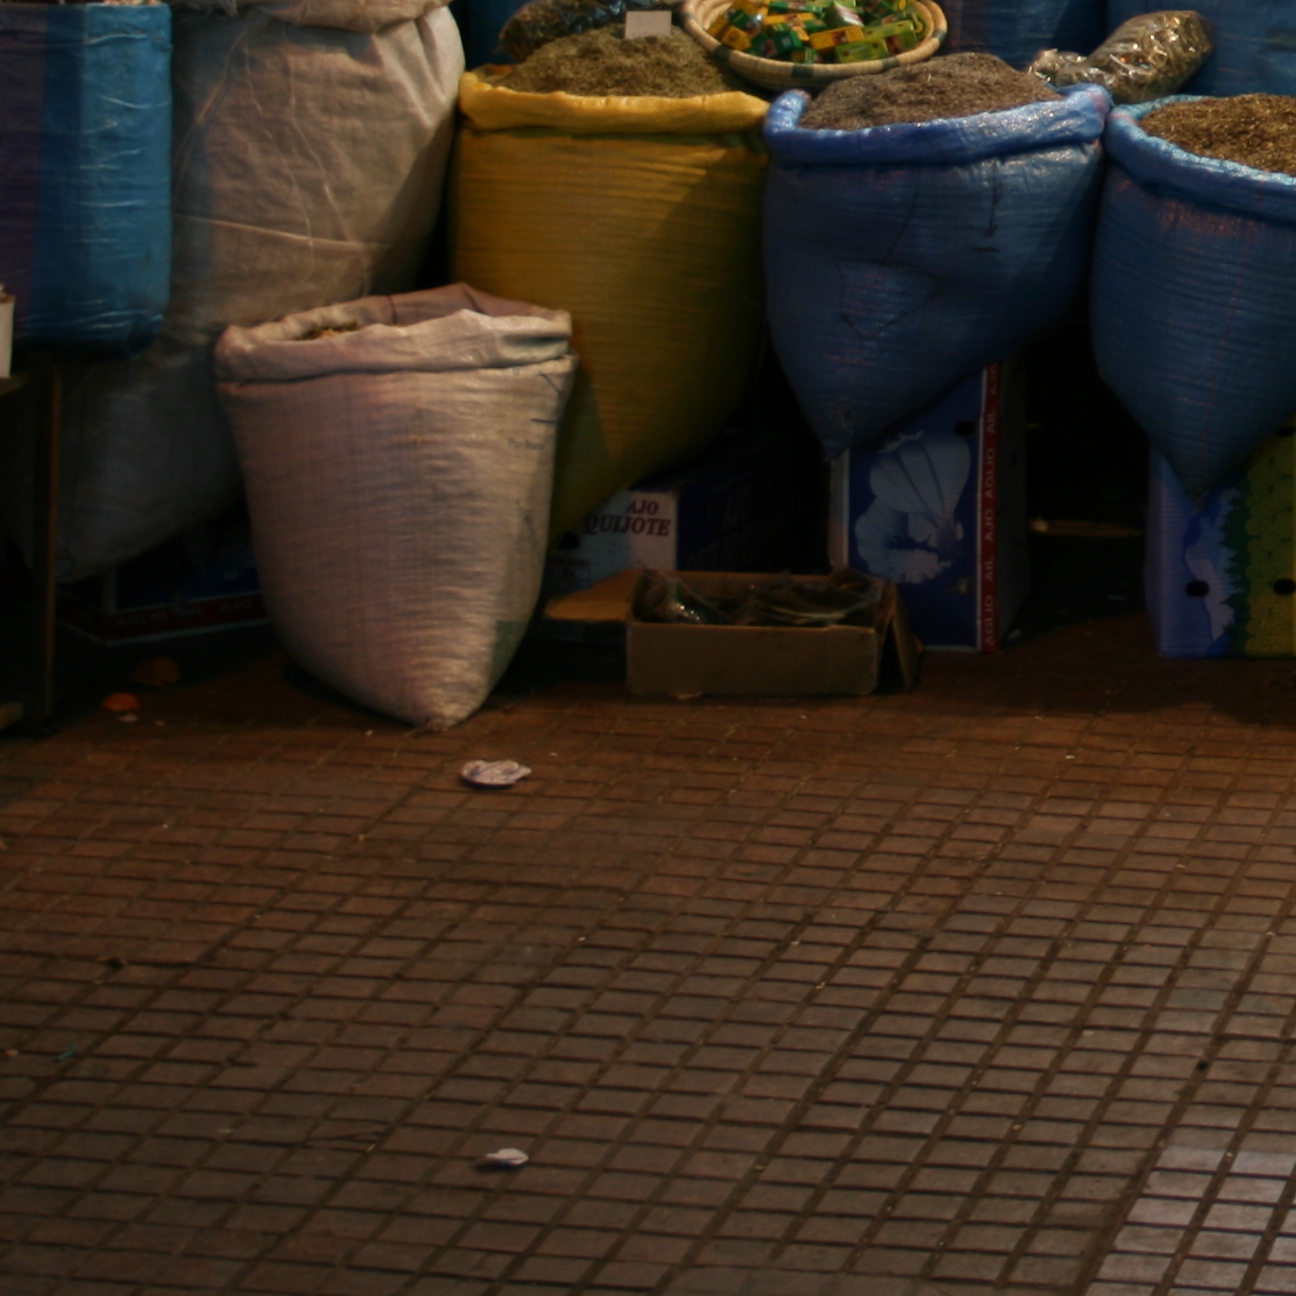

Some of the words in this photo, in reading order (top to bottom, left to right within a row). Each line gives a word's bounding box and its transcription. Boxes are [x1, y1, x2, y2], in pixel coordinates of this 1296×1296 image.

[985, 447, 995, 498] AGLIO
[626, 500, 659, 515] AJO
[584, 513, 671, 536] QUIJOTE
[985, 508, 994, 541] AJO
[985, 556, 994, 581] AIL
[985, 594, 994, 645] AGLIO
